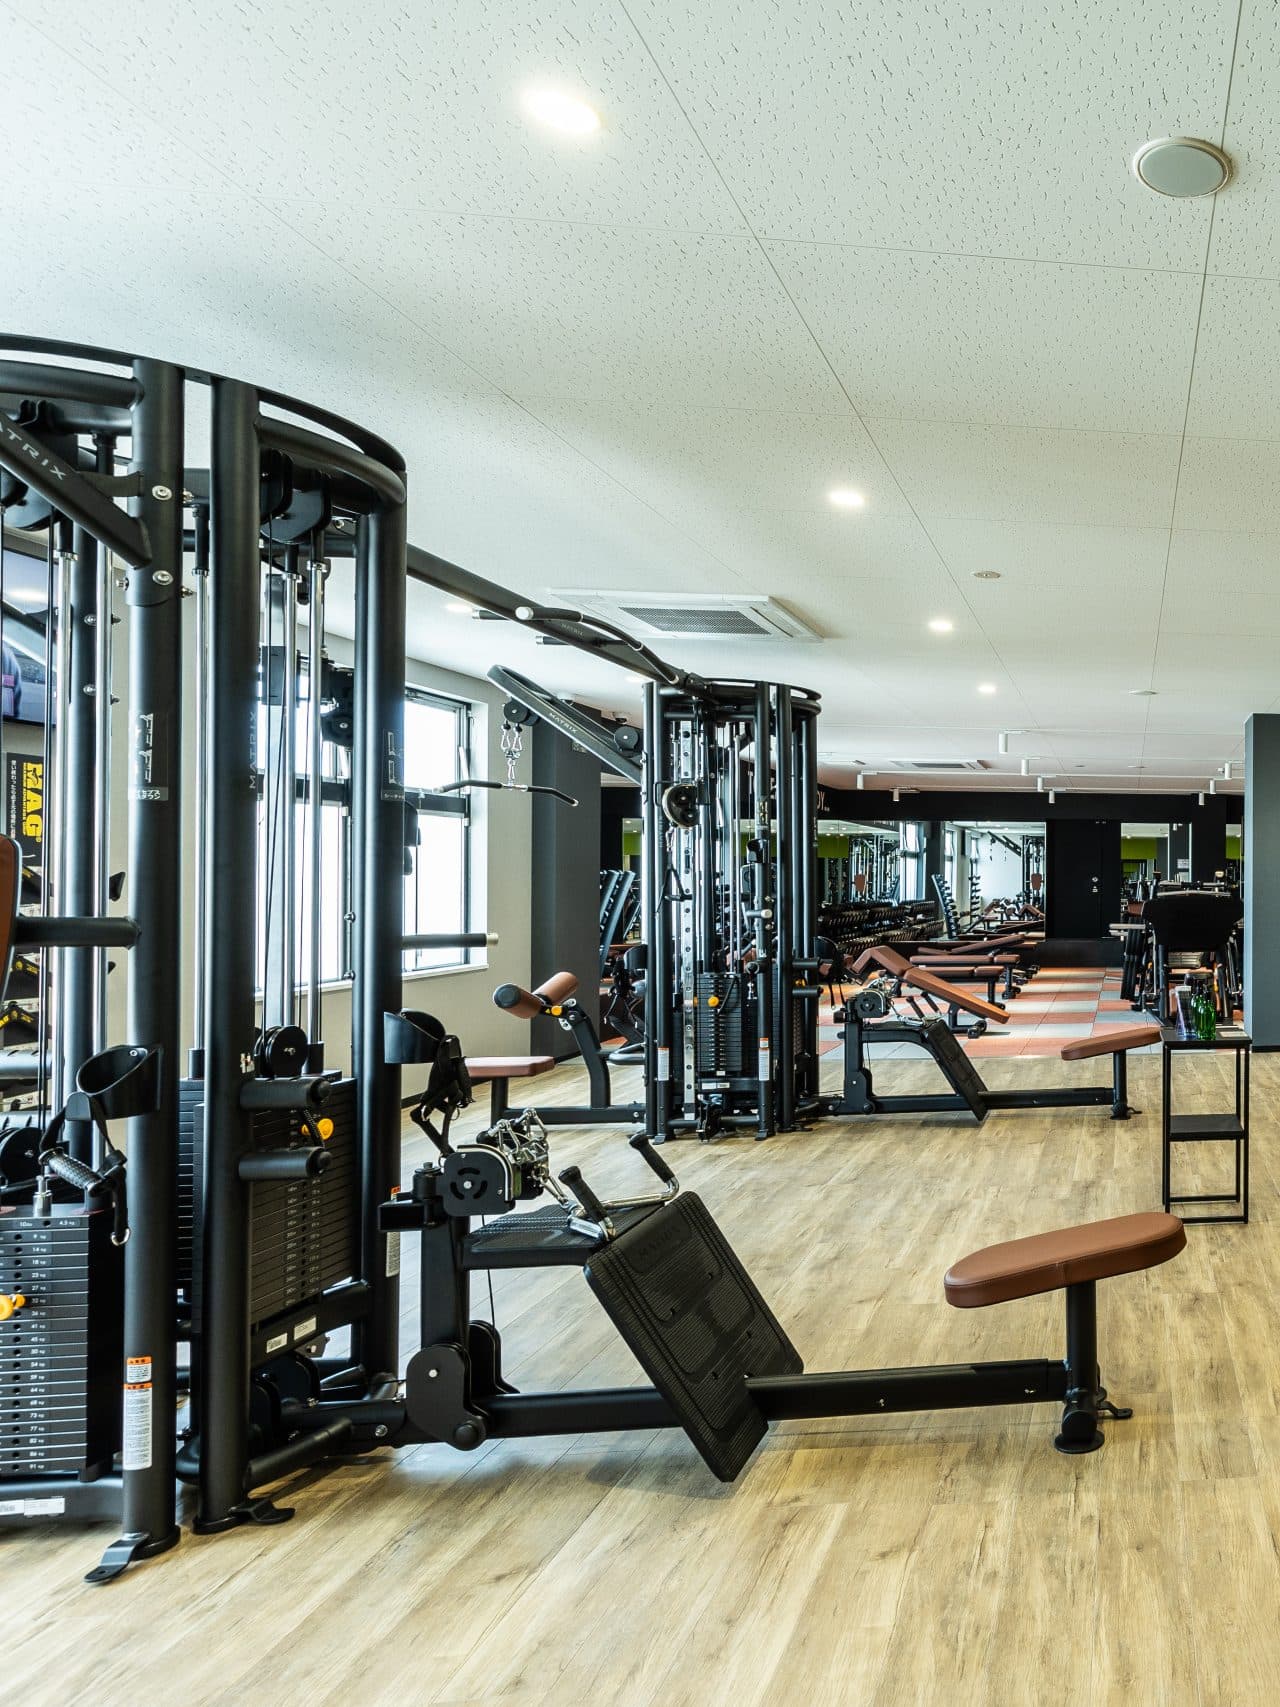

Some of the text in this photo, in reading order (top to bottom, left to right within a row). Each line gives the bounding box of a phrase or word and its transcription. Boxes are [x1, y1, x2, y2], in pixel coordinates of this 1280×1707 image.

[248, 711, 258, 789] MATRIX
[549, 712, 579, 734] MATRIX
[26, 762, 43, 837] MAG
